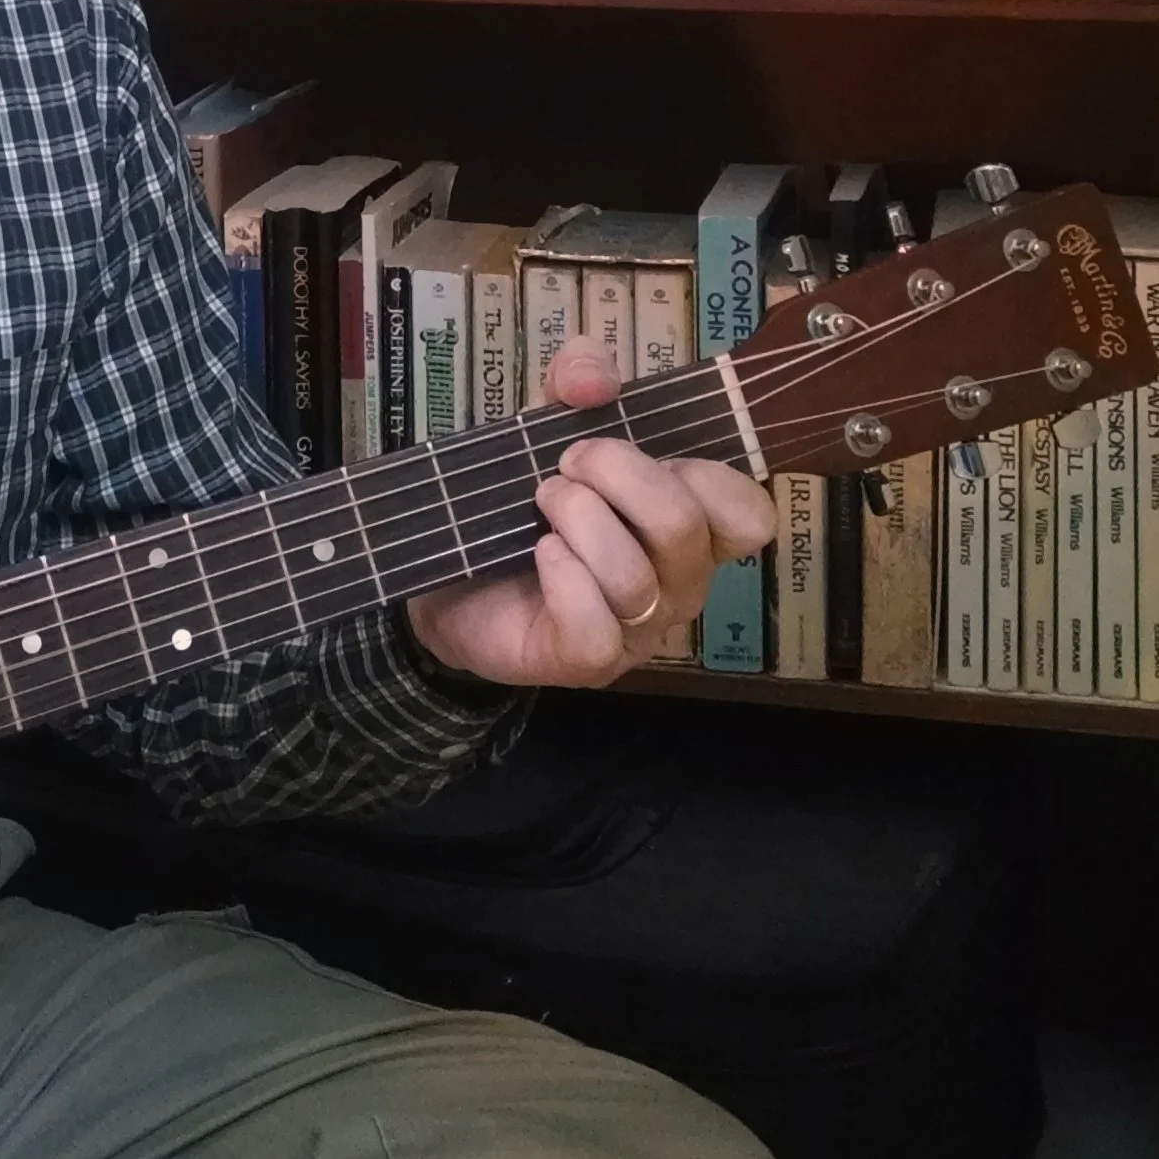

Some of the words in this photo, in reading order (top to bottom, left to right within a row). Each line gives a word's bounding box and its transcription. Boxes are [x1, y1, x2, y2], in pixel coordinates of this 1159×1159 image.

[730, 234, 754, 255] A
[292, 246, 310, 329] DOROTHY
[365, 311, 375, 361] JUMPERS
[484, 308, 502, 342] The
[540, 318, 552, 336] OF
[604, 318, 617, 345] THE
[647, 342, 660, 360] OF
[387, 306, 405, 398] JOSEPHINE
[540, 340, 552, 369] THE
[295, 350, 312, 410] SAYERS
[390, 404, 405, 437] TEY
[999, 432, 1014, 470] THE
[1034, 418, 1050, 495] ECSTASY
[788, 476, 810, 528] J.R.R.
[998, 474, 1016, 522] LION
[1068, 494, 1084, 551] Williams
[1108, 486, 1124, 544] Williams
[790, 529, 812, 594] Tolkien
[958, 506, 975, 566] Williams
[1000, 533, 1014, 588] Williams
[1033, 508, 1048, 566] Williams
